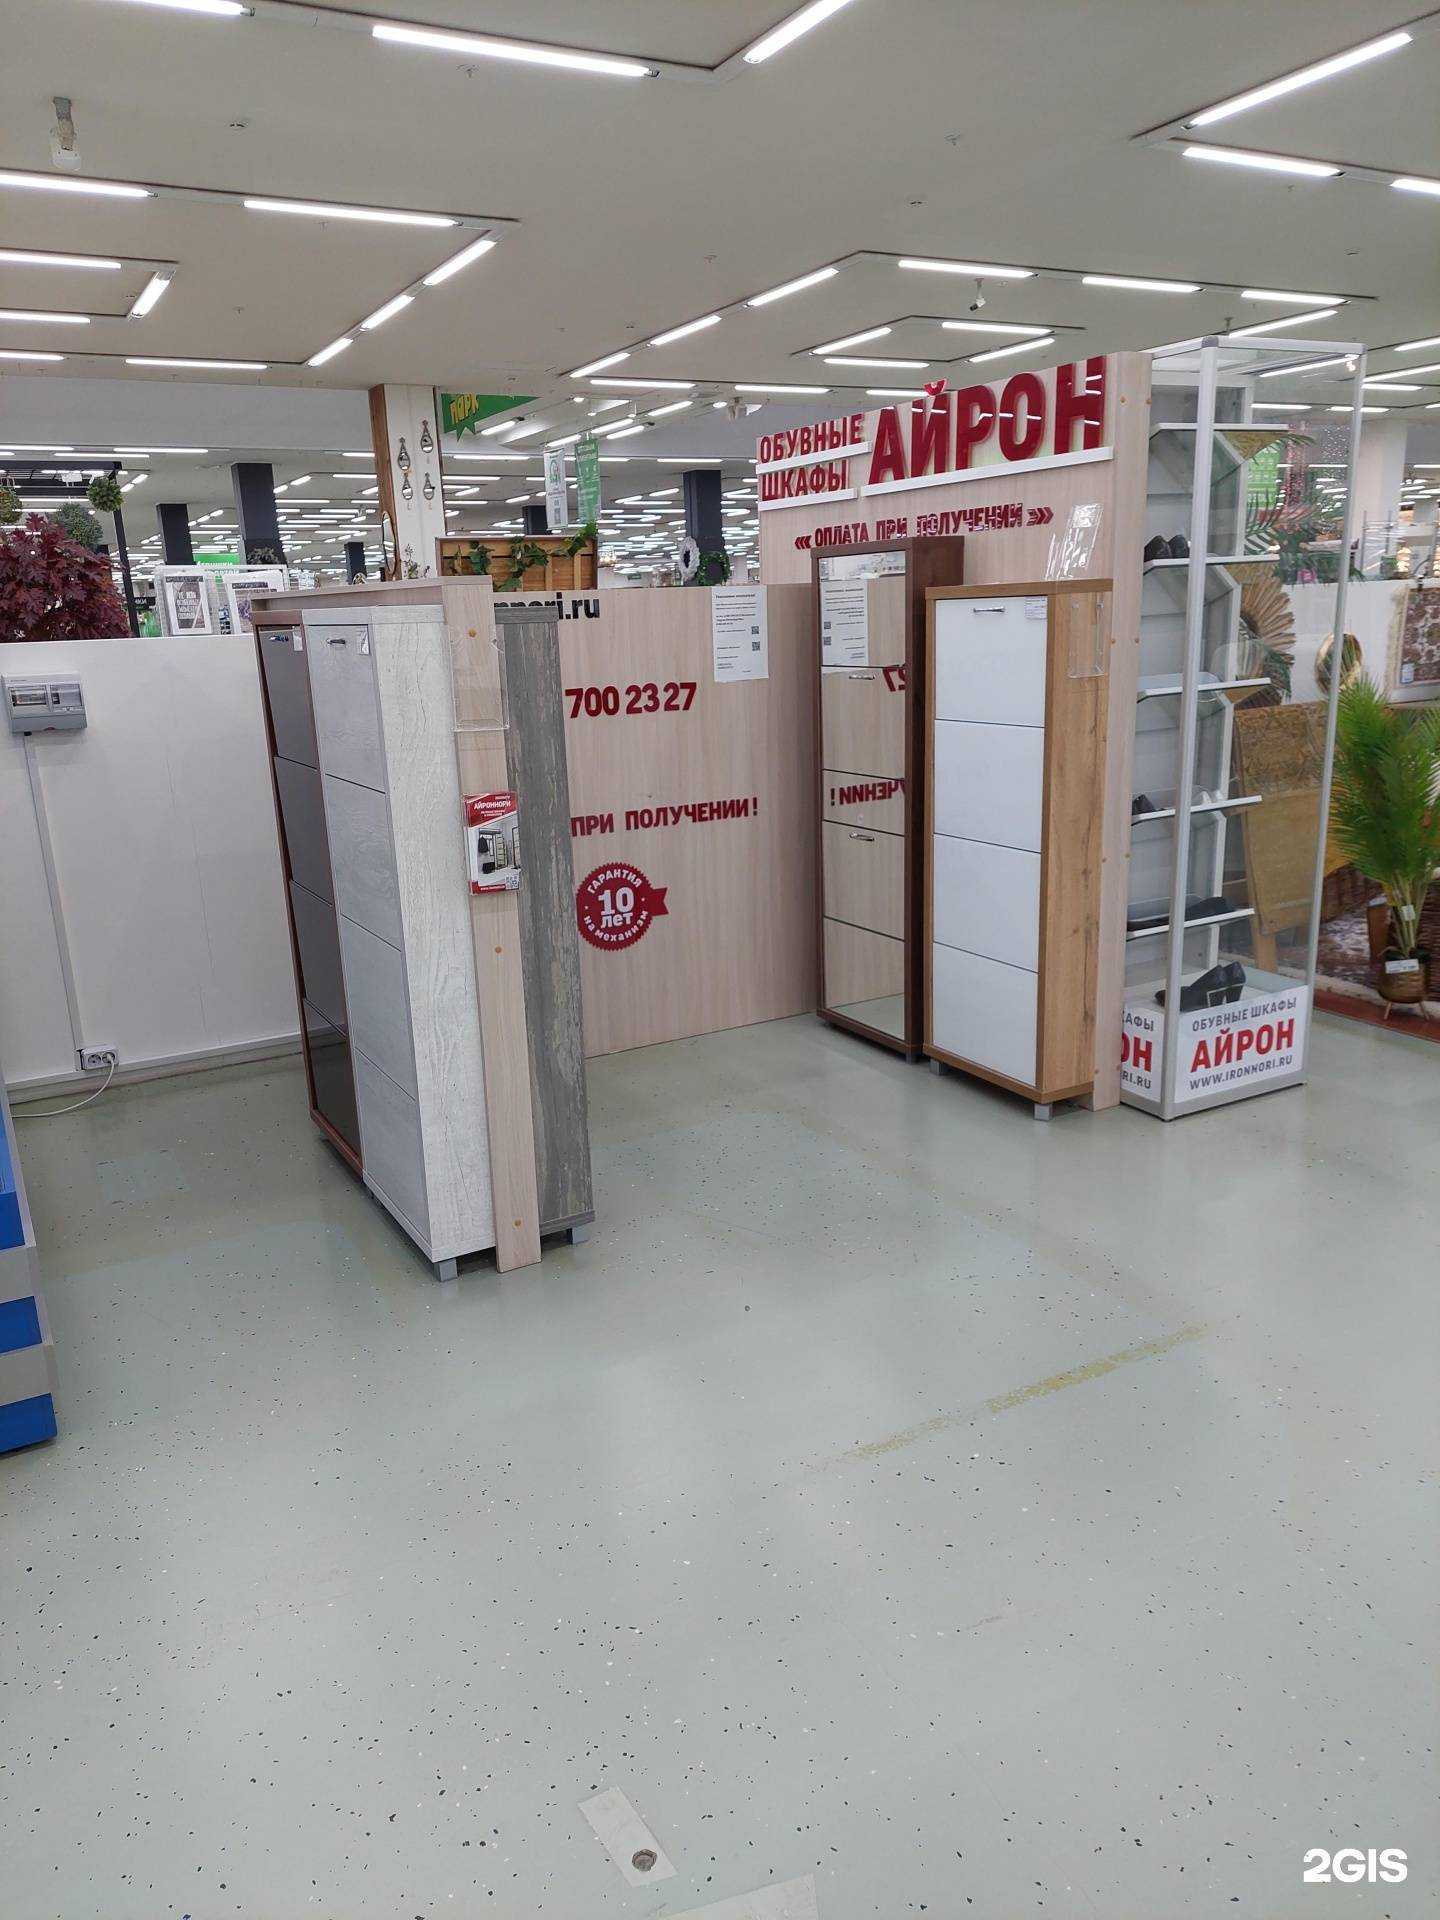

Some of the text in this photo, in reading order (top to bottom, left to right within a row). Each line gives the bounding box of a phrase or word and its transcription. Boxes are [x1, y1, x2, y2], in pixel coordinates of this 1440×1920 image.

[868, 355, 1105, 485] АЙРОН
[760, 413, 864, 464] ОБУВНЫЕ
[761, 459, 848, 501] ШКАФЫ
[814, 503, 1024, 547] ОПЛАТА ПРИ ПОЛУЧЕНИИ
[493, 592, 600, 619] i.ru
[565, 681, 697, 718] 700 23 27
[571, 813, 614, 837] ПРИ
[587, 868, 643, 894] ГАРАНТИЯ
[598, 886, 635, 916] 10
[594, 910, 649, 942] механизм
[600, 912, 634, 929] лет
[1122, 1011, 1154, 1032] АФЫ
[1192, 997, 1297, 1032] ОБУВНЫЕ ШКАФЫ
[1190, 1018, 1295, 1074] АЙРОН
[1189, 1055, 1293, 1090] WWW.IRONNORI.RU
